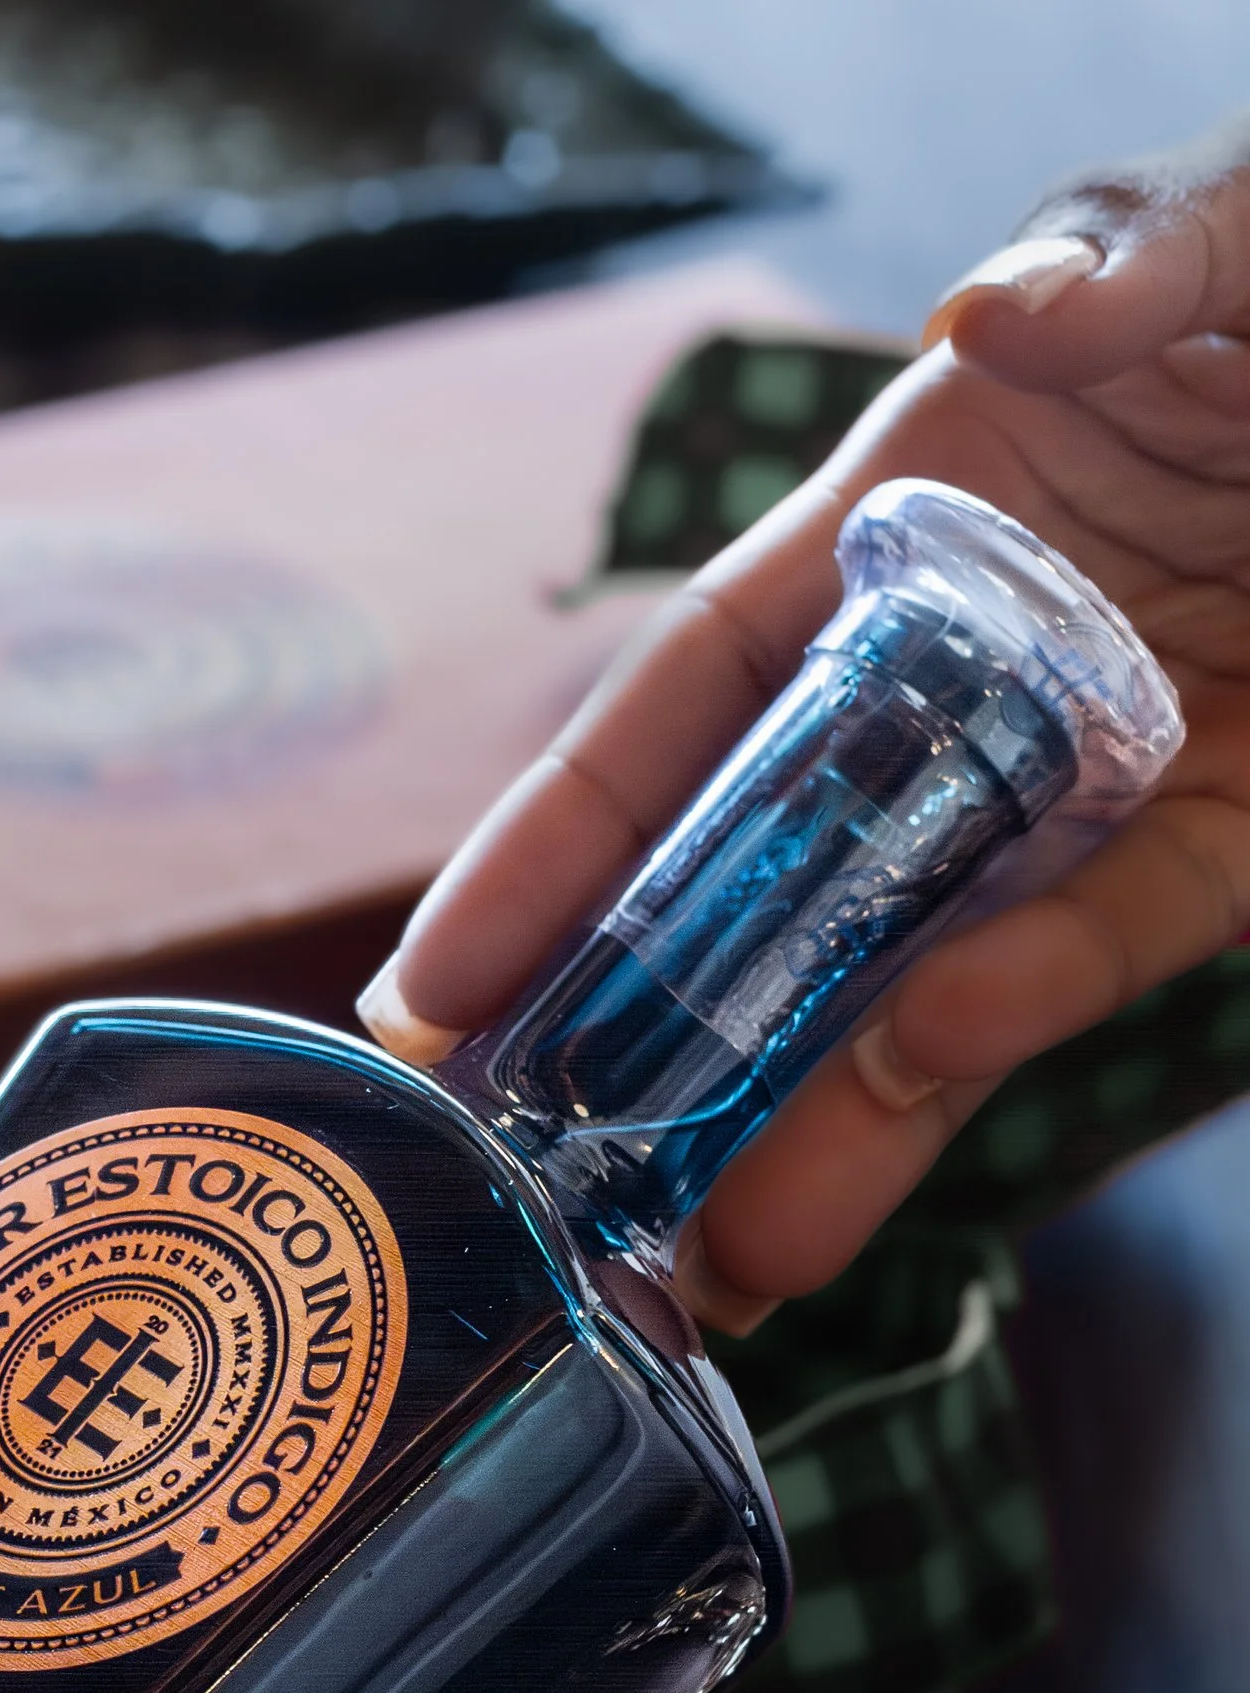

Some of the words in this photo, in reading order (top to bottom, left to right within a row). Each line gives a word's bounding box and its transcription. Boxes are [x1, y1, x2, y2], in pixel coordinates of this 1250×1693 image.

[15, 1242, 236, 1305] ESTABLISHED
[211, 1314, 250, 1430] MMXXI
[46, 1152, 332, 1268] ESTOICO
[230, 1267, 353, 1526] INDIGO
[29, 1468, 182, 1528] MÉXICO
[16, 1573, 157, 1615] AZUL
